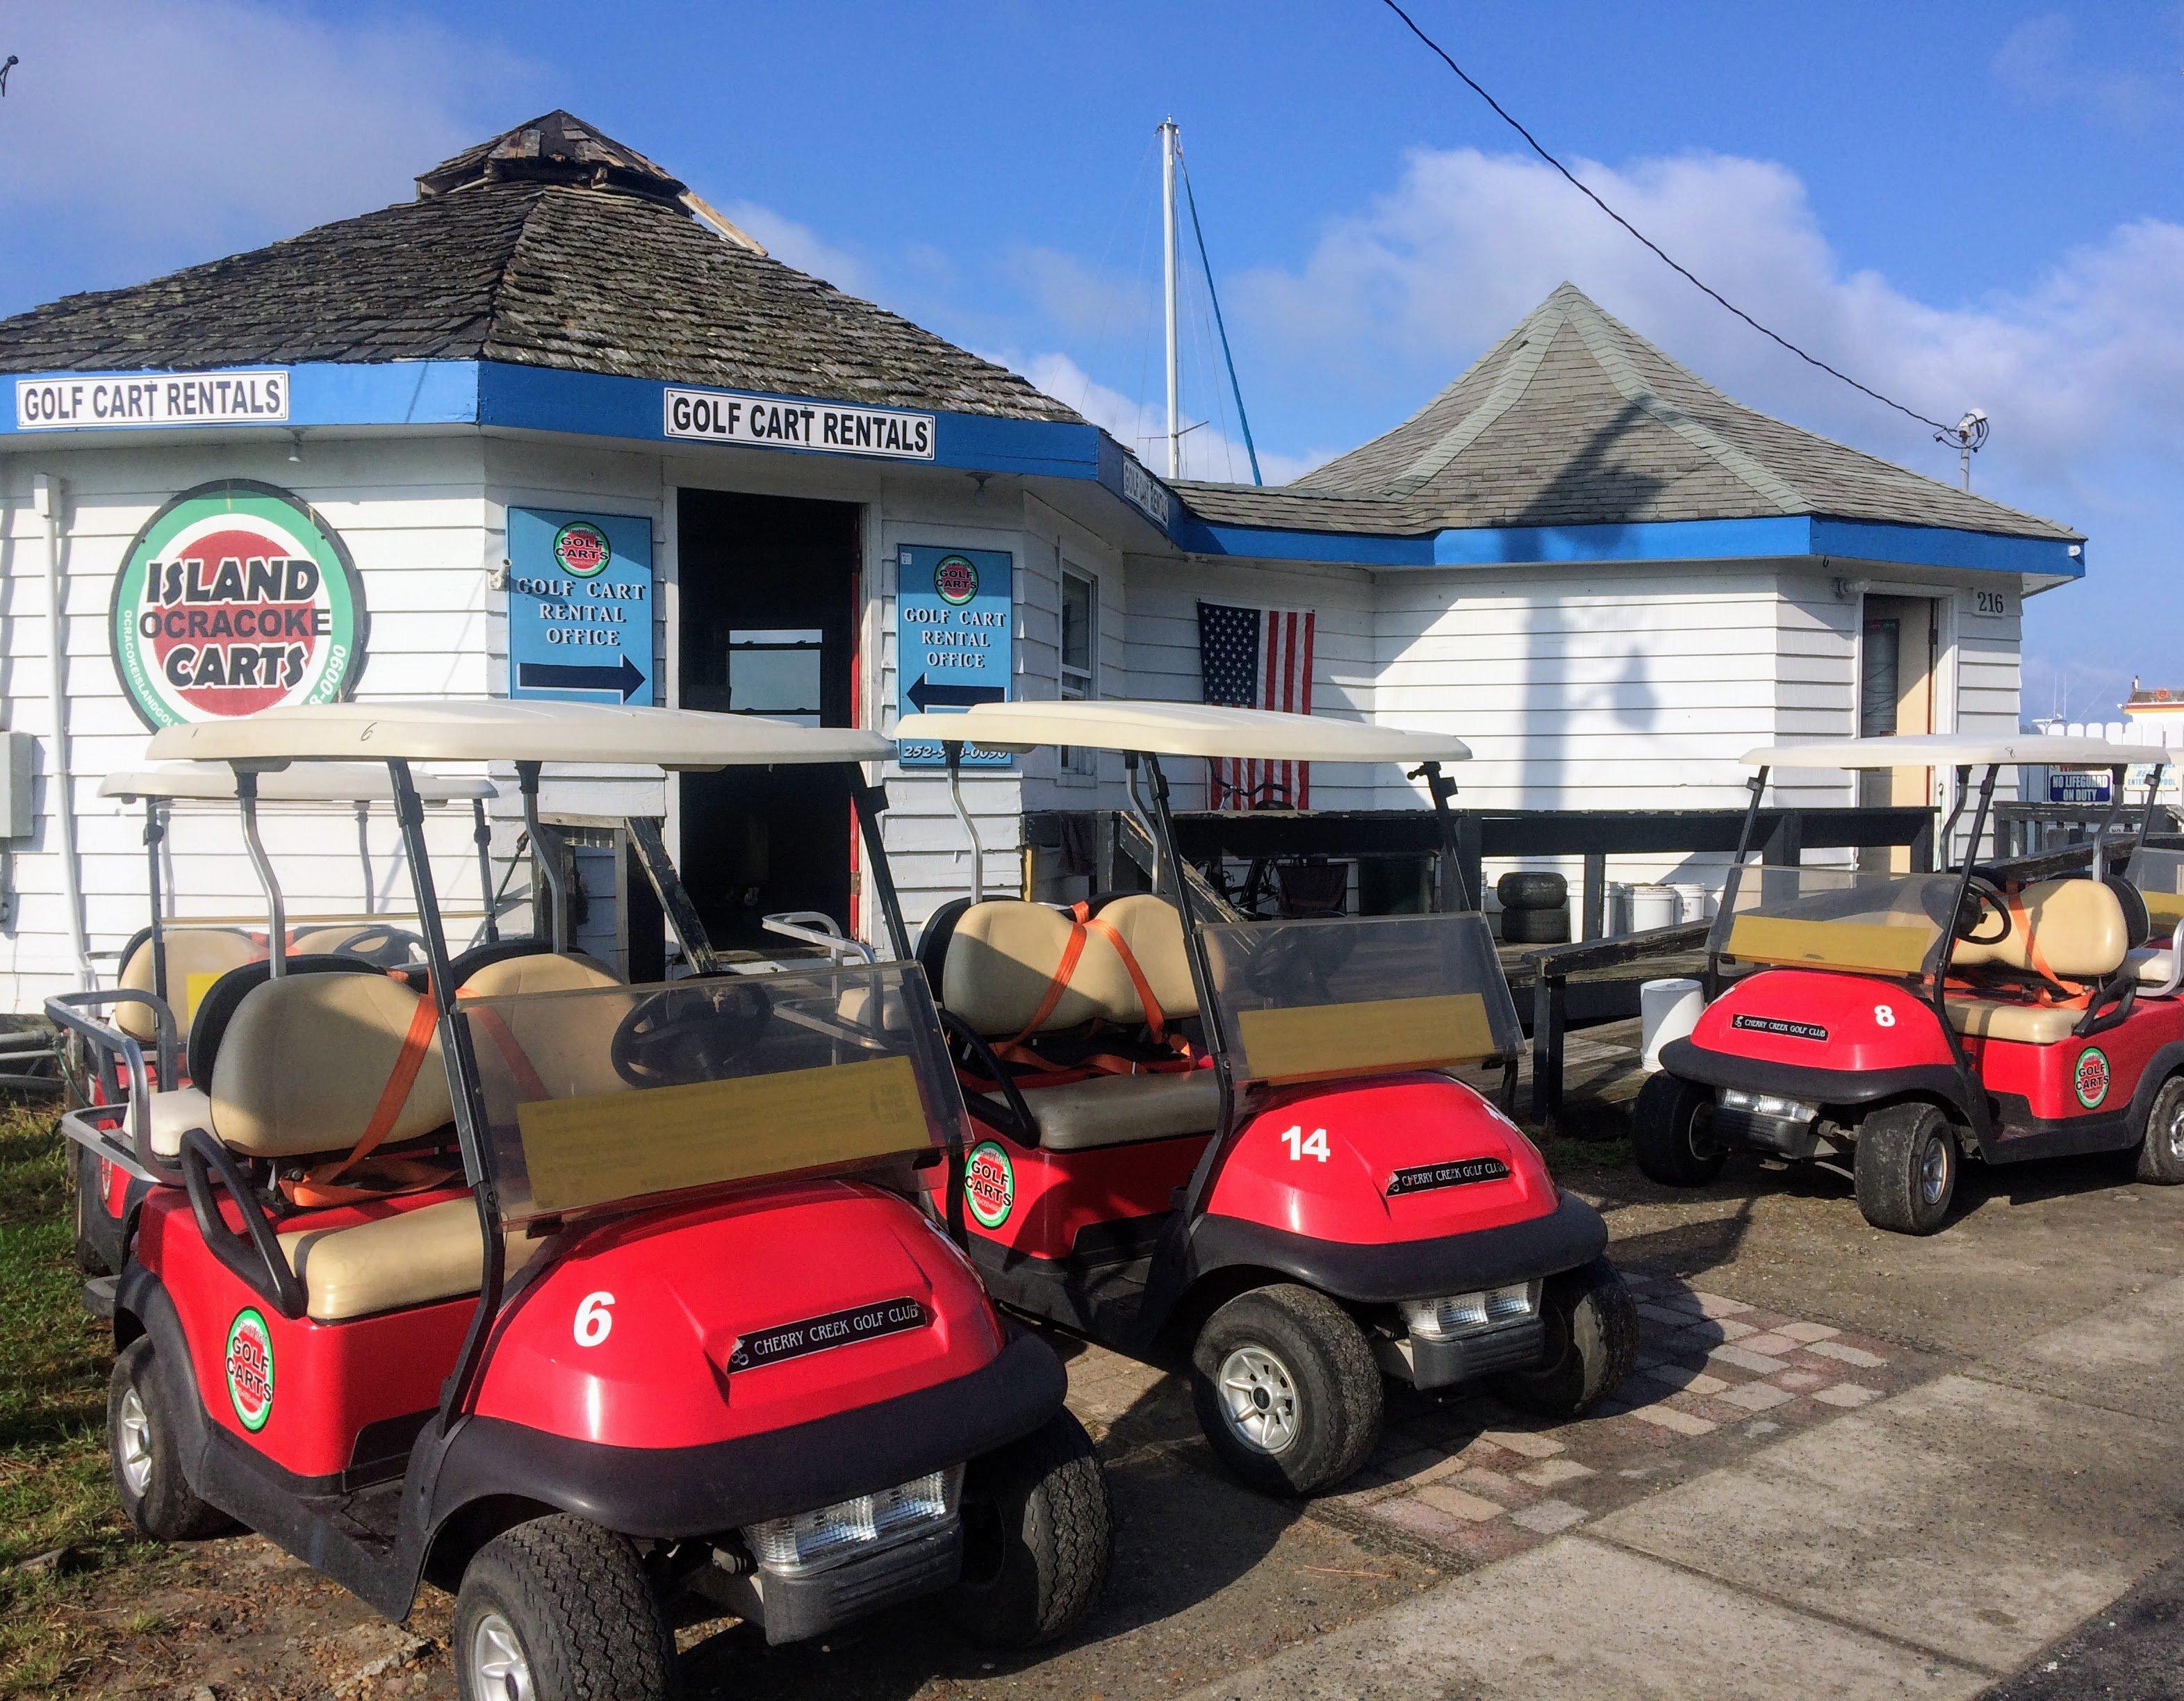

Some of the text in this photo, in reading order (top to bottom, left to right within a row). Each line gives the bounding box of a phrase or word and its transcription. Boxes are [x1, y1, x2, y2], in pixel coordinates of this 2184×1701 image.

[24, 379, 281, 420] GOLF CART RENTALS
[672, 397, 929, 453] GOLF CART RENTALS
[555, 548, 609, 560] CARTS
[561, 537, 603, 548] GOLF
[145, 559, 320, 605] ISLAND
[935, 579, 977, 589] CARTS
[939, 570, 973, 579] GOLF
[516, 577, 646, 600] GOLF CART
[539, 603, 627, 623] RENTAL
[1978, 591, 2003, 614] 216
[140, 608, 331, 639] OCRACOKE
[904, 608, 1006, 627] GOLF CART
[546, 627, 621, 646] OFFICE
[921, 630, 991, 647] RENTAL
[165, 643, 308, 690] CARTS
[926, 652, 985, 668] OFFICE
[2053, 775, 2108, 788] NO LIFEGUARD
[2062, 789, 2098, 800] ON DUTY
[1744, 1019, 1826, 1037] CHERRY CREEK GOLF CLUB
[1874, 1005, 1896, 1028] 8
[2078, 1063, 2105, 1078] GOLF
[2076, 1075, 2109, 1091] CARTS
[1281, 1125, 1331, 1162] 14
[971, 1160, 1009, 1185] GOLF
[1402, 1162, 1504, 1187] CHERRY CREEK GOLF CLUB
[964, 1174, 1012, 1208] CARTS
[573, 1291, 615, 1348] 6
[754, 1305, 919, 1356] CHERRY CREEK GOLF CLUB
[231, 1335, 270, 1373] GOLF
[226, 1356, 272, 1403] CARTS
